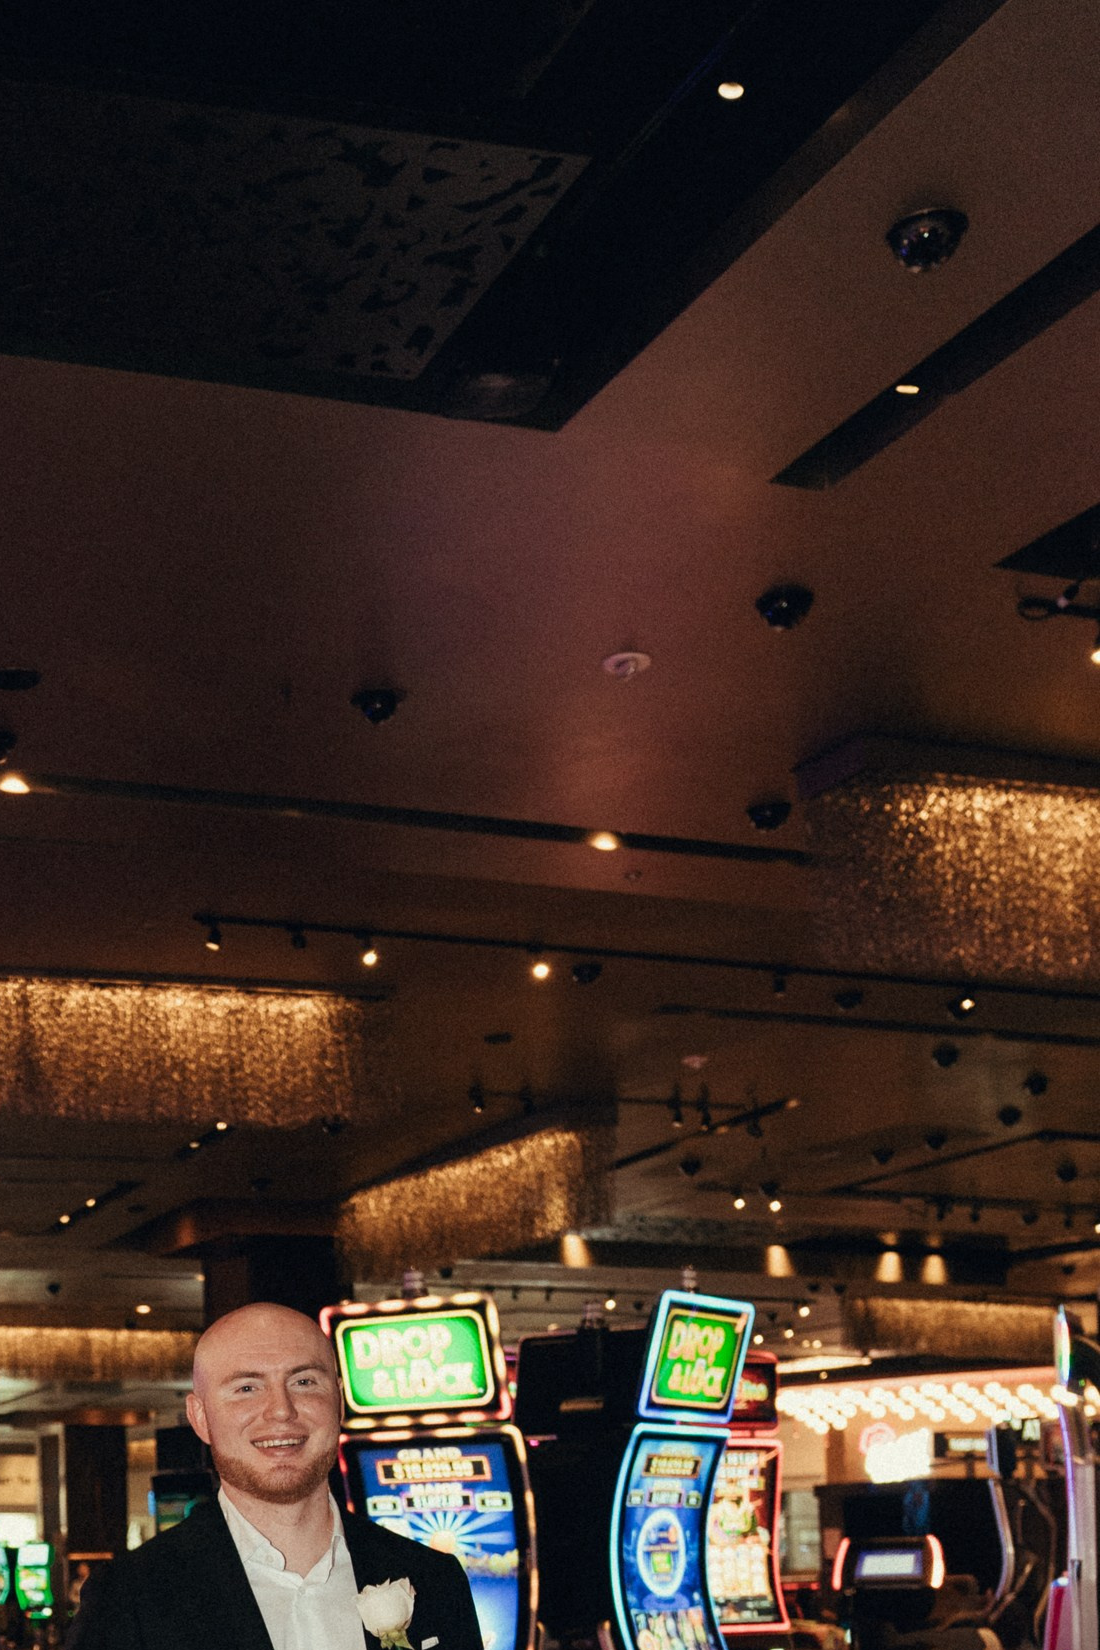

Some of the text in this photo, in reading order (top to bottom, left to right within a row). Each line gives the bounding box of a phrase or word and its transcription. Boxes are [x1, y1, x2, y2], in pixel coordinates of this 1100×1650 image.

[350, 1323, 452, 1369] DROP
[667, 1320, 726, 1367] DROP
[397, 1447, 462, 1461] GRAND
